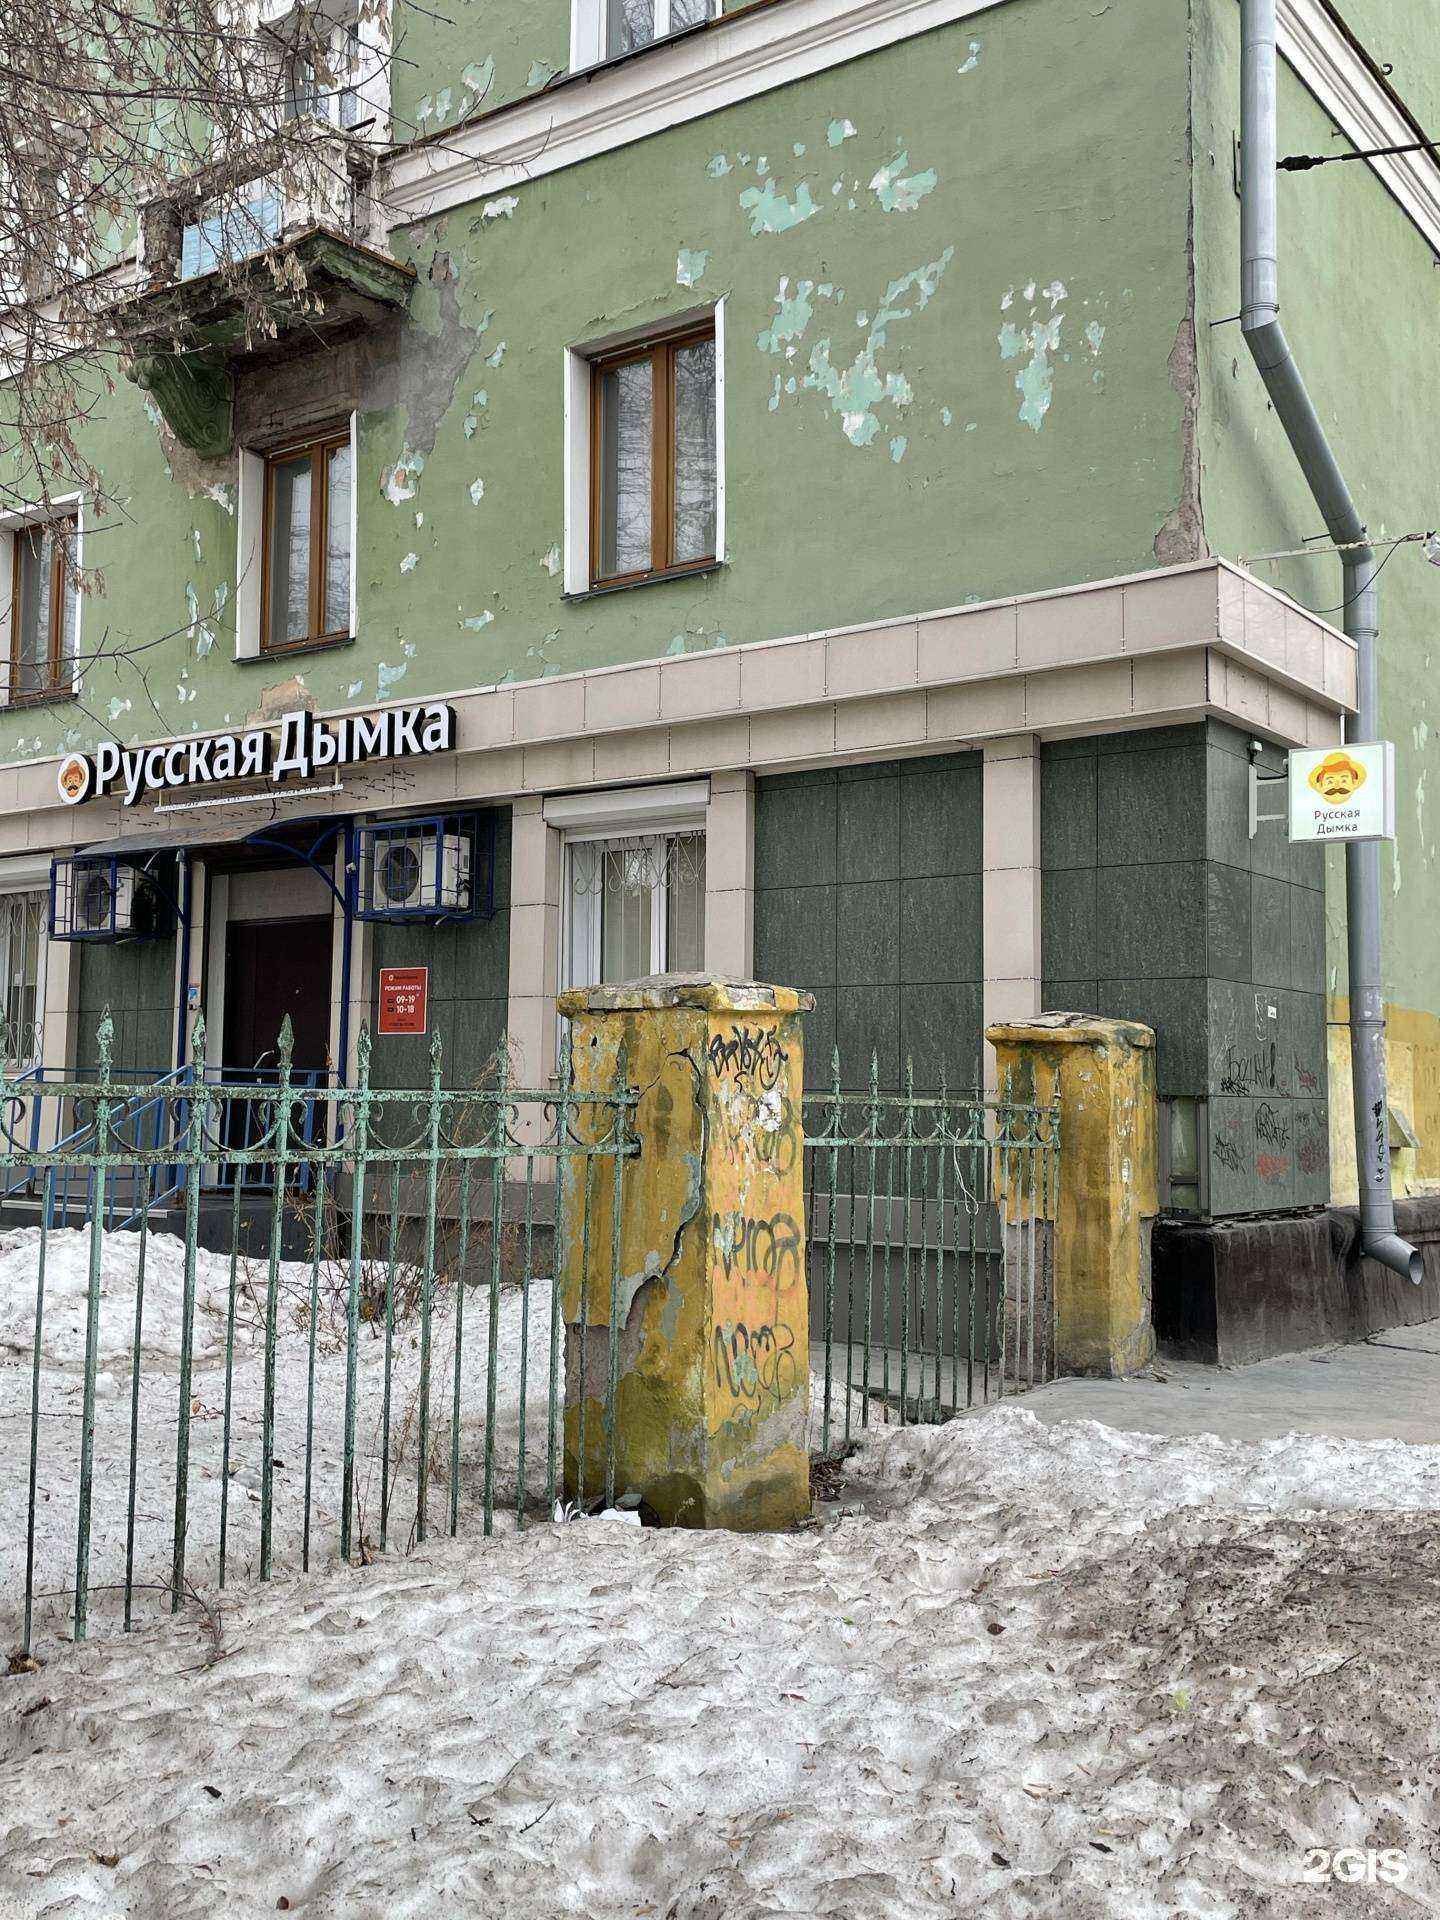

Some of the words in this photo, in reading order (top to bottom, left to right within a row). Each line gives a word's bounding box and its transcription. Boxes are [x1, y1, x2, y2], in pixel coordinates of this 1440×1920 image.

[96, 731, 268, 806] Русская
[273, 703, 455, 782] Дымка
[1314, 808, 1361, 822] Русская
[1317, 823, 1358, 835] Дымка
[396, 995, 416, 1004] 09-19
[396, 1005, 416, 1014] 10-18
